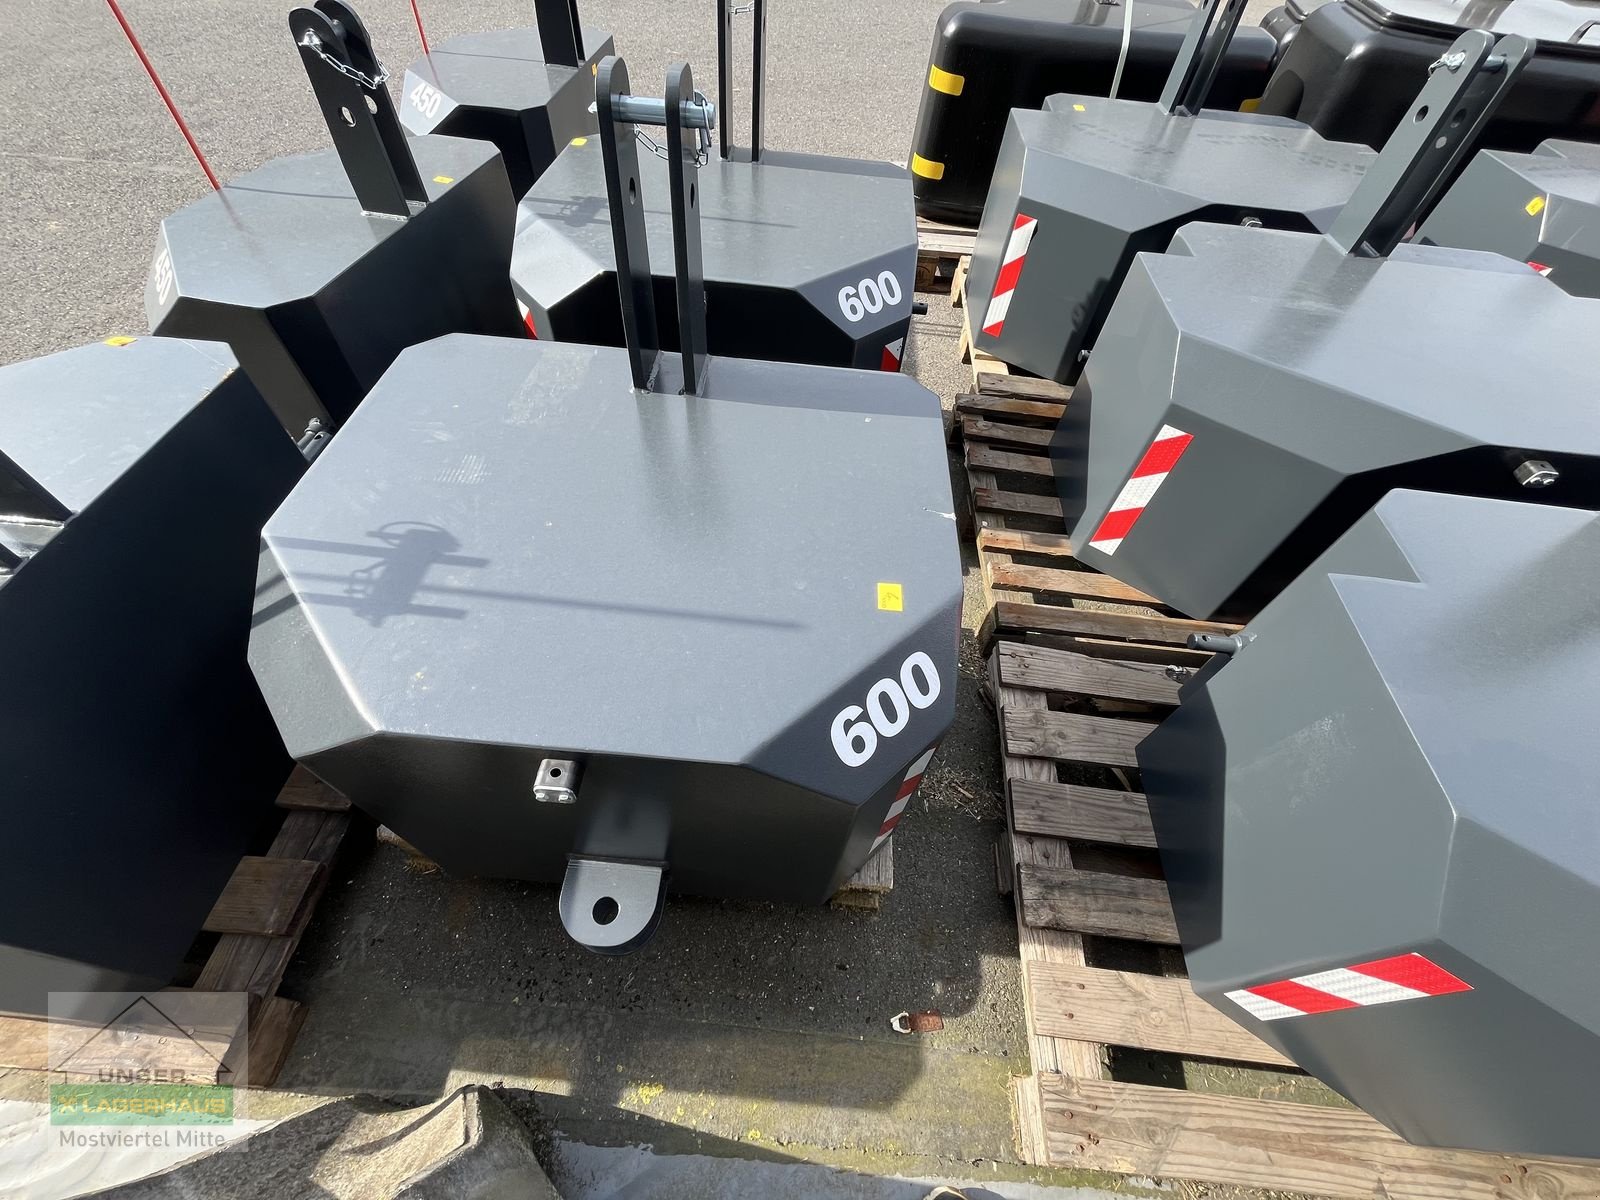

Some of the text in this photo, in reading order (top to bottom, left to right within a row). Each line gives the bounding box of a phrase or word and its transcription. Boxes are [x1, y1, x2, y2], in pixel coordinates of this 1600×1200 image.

[410, 82, 442, 118] 450
[154, 247, 173, 306] 450
[838, 270, 902, 322] 600
[830, 651, 941, 768] 600
